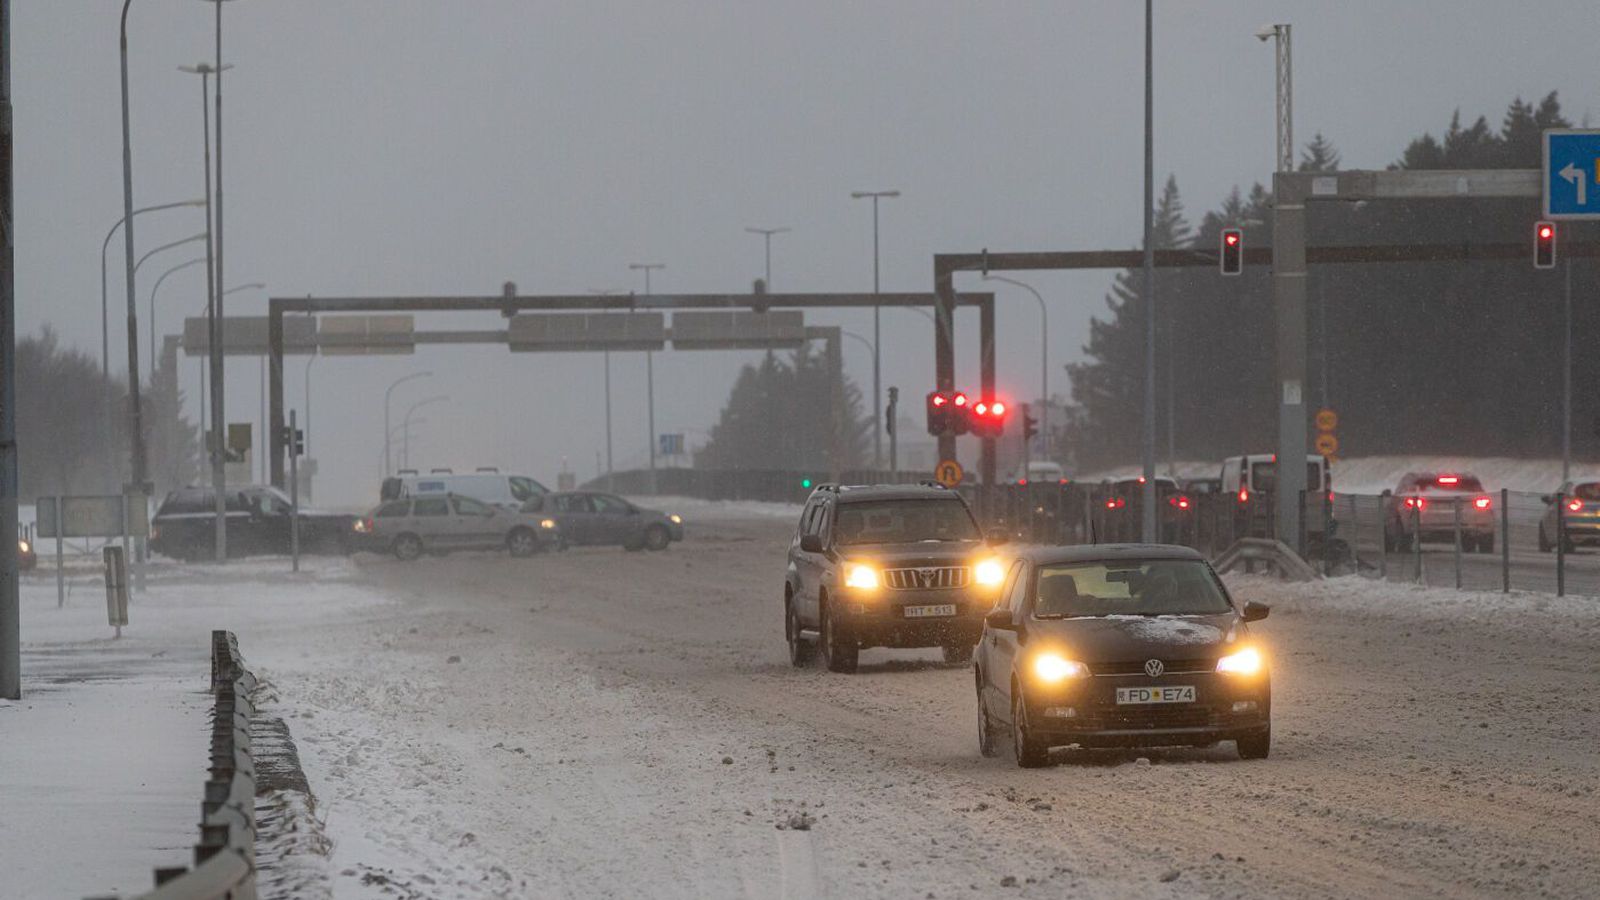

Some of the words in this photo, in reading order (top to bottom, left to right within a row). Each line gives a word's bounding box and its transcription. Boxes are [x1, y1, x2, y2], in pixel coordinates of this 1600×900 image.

[1145, 659, 1163, 677] VW
[1129, 690, 1150, 702] FD
[1163, 688, 1192, 701] E74
